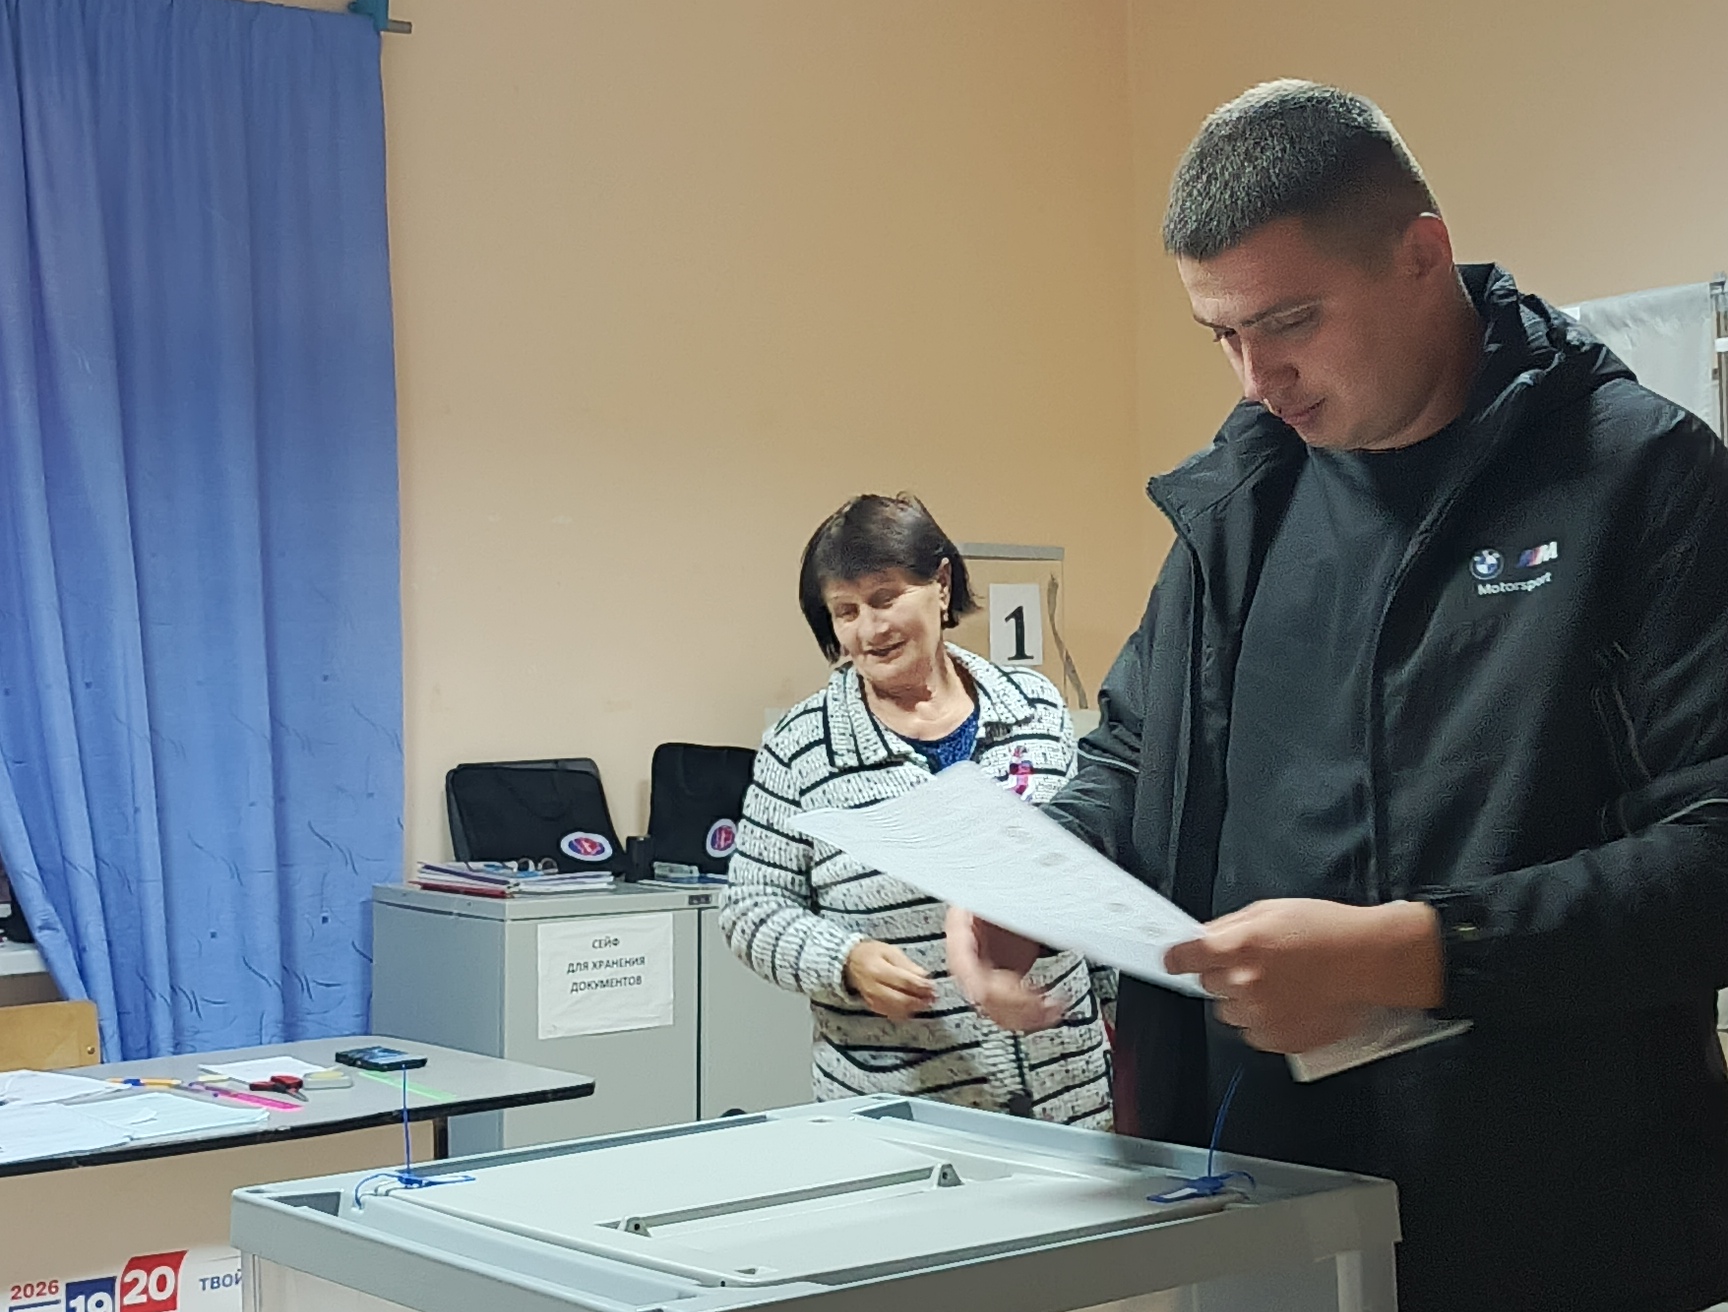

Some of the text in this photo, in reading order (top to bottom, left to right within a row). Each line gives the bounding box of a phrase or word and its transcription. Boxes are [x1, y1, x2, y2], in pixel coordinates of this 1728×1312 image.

[1477, 572, 1552, 596] Motorsport
[1004, 605, 1034, 660] 1
[591, 935, 620, 949] СЕЙФ
[566, 955, 646, 975] ДЛЯ ХРАНЕНИЯ
[570, 975, 642, 994] ДОКУМЕНТОВ
[10, 1279, 60, 1300] 2026
[123, 1265, 175, 1306] 20
